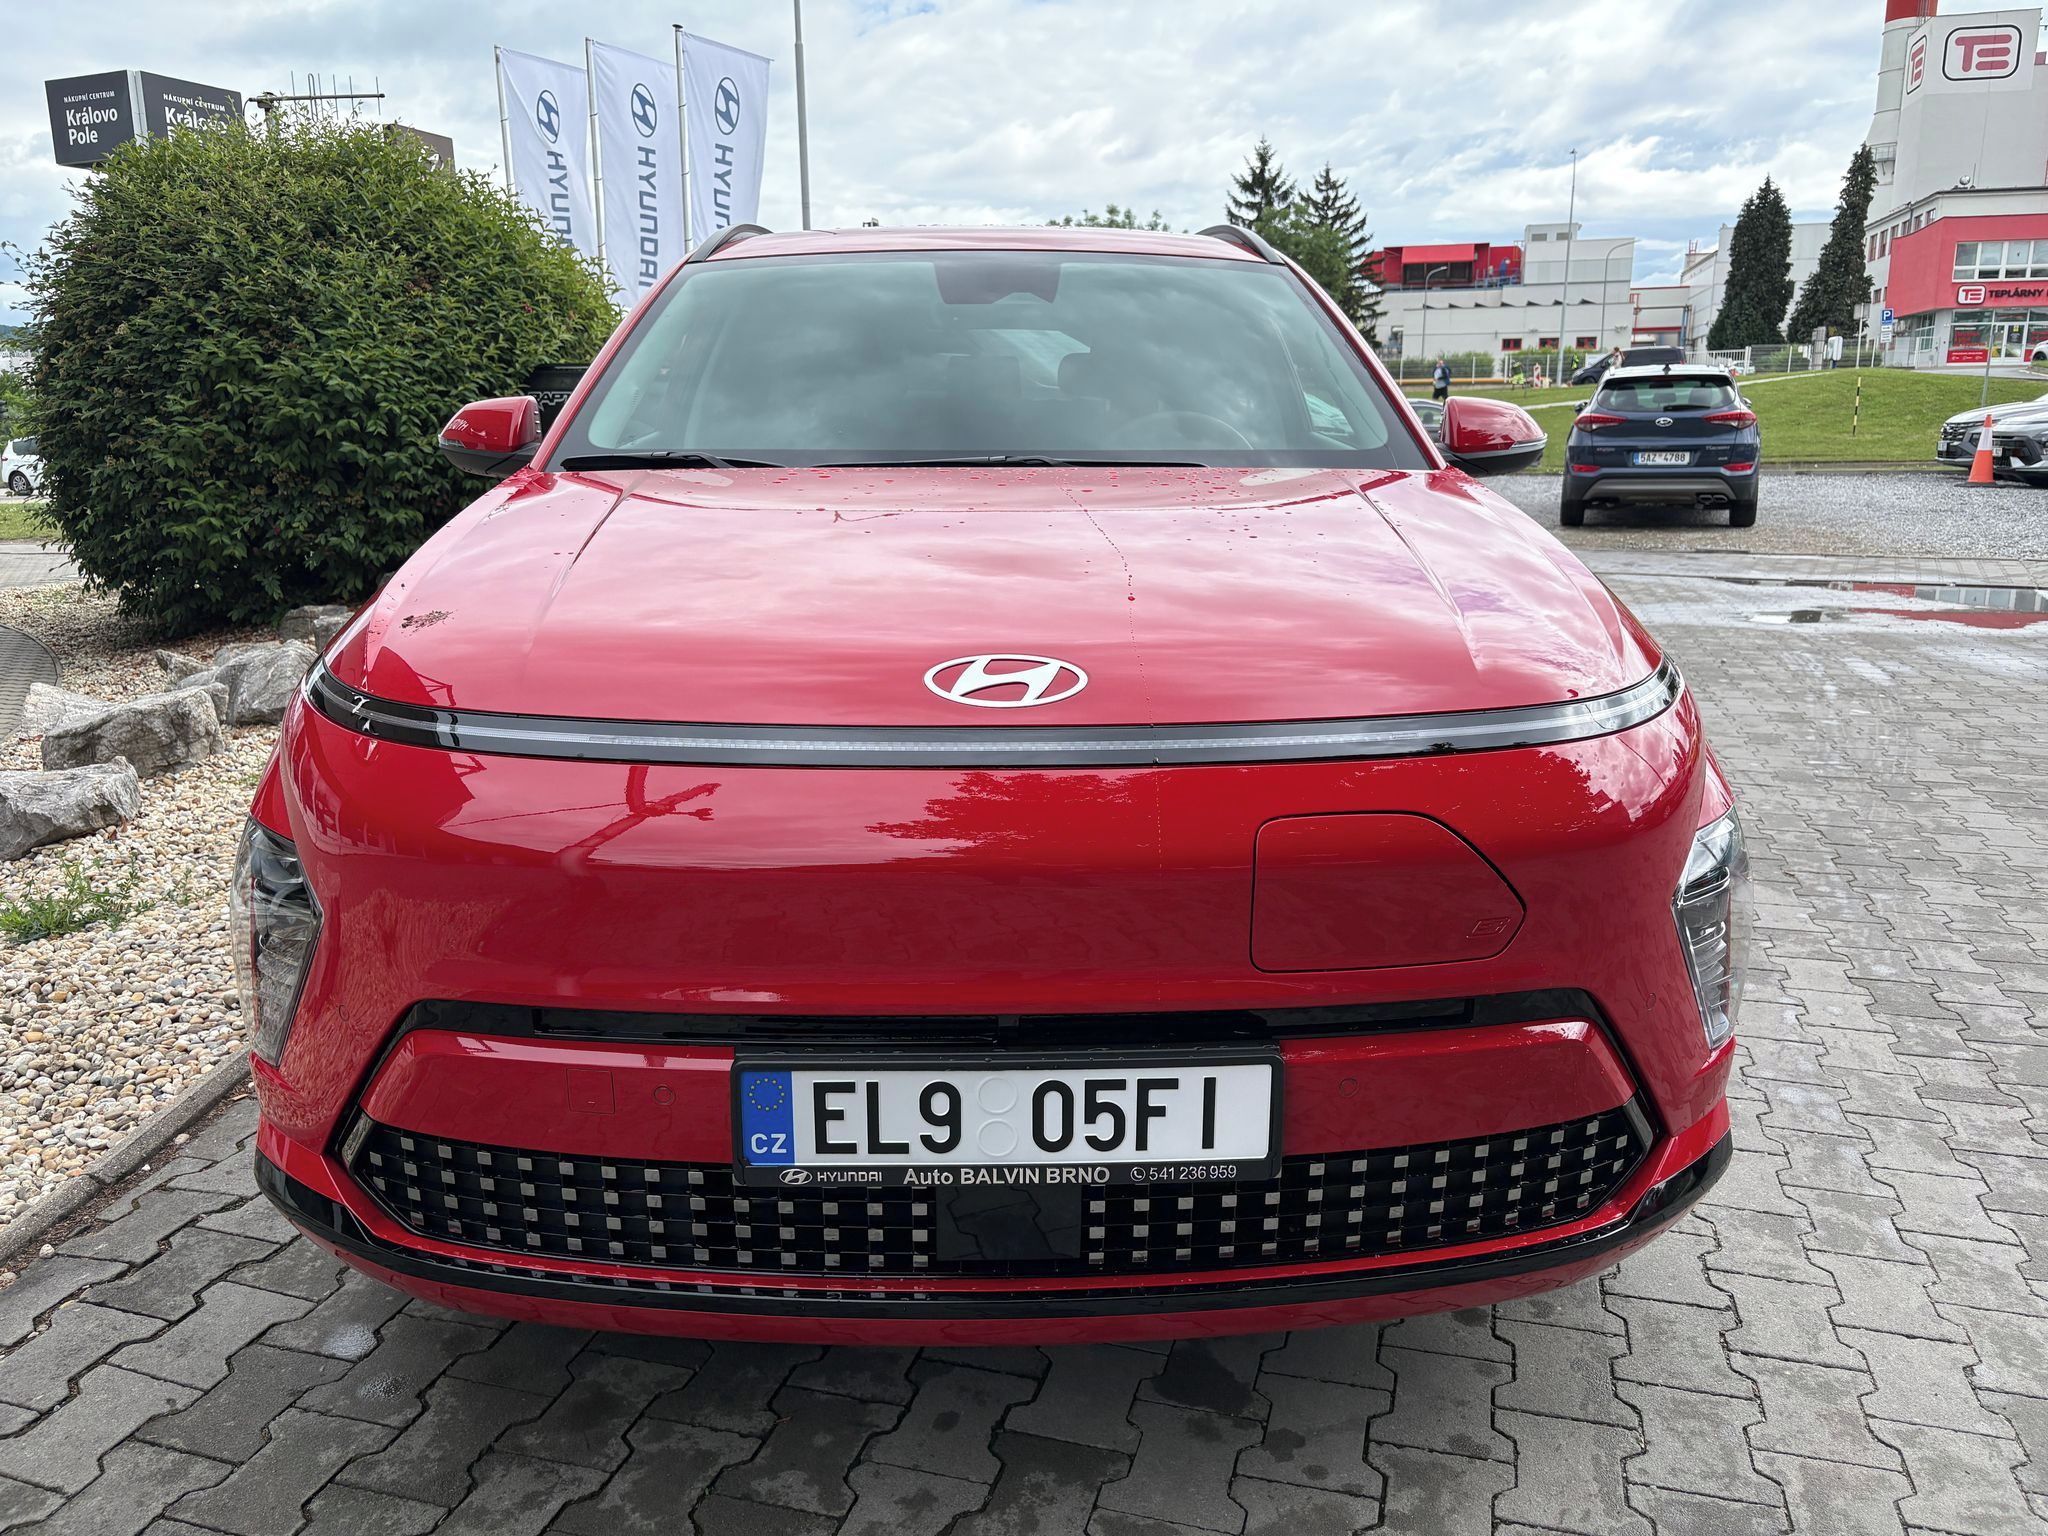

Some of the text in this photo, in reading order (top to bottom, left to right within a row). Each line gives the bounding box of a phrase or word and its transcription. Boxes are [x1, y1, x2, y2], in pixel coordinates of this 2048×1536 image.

[63, 90, 115, 103] NÁKUPNÍ CENTRUM
[163, 93, 193, 105] NÁKUPNÍ
[66, 106, 118, 127] Královo
[68, 126, 98, 146] Pole
[637, 146, 658, 287] HYUNDAI
[1989, 287, 2044, 298] TEPLÁRNY
[1663, 453, 1686, 462] 4788
[813, 1080, 962, 1155] EL9
[750, 1133, 787, 1154] CZ
[816, 1164, 1237, 1185] HYUNDAI Auto BALVIN BRNO 541 236 959
